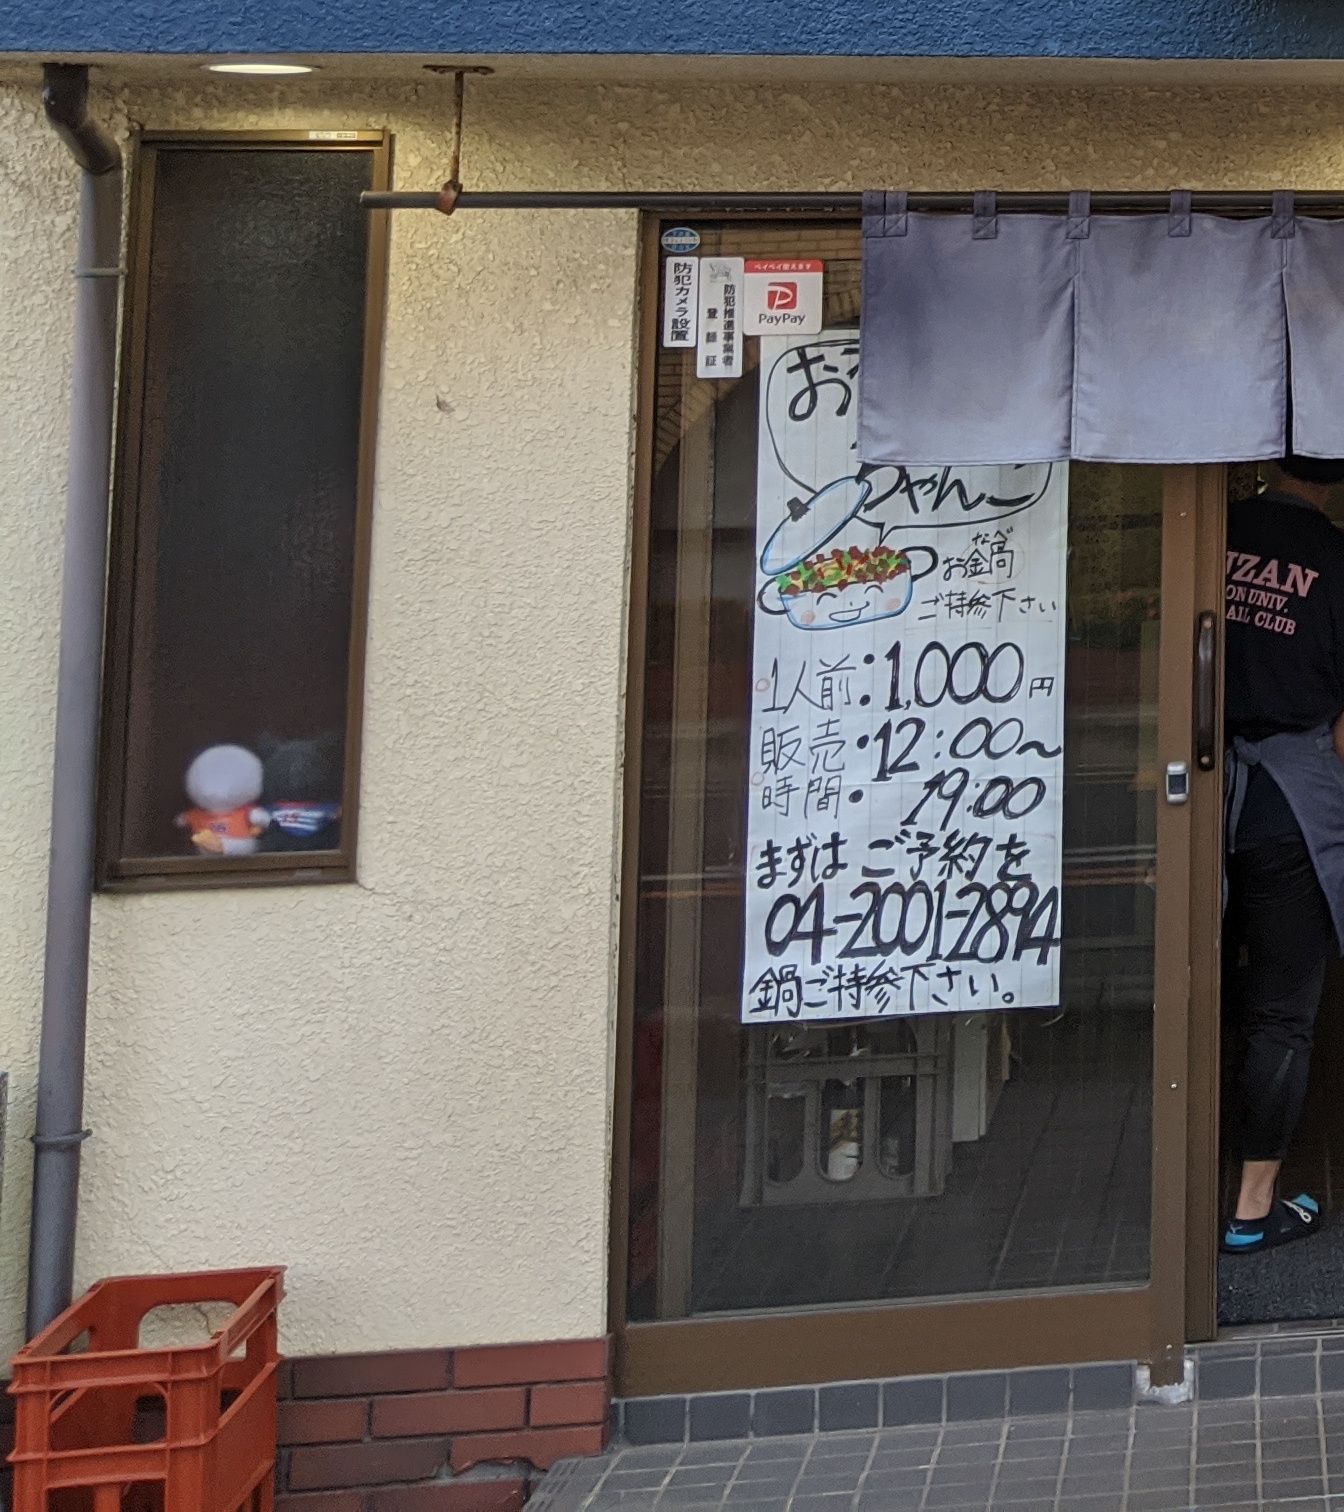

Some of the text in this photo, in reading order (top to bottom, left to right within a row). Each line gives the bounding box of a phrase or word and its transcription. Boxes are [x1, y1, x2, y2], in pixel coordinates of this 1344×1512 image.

[670, 262, 693, 342] 防犯カメラ設置
[758, 313, 806, 326] PayPay
[918, 588, 1057, 622] ご持参下さい
[1248, 589, 1289, 613] UNIV.
[1254, 611, 1297, 636] CLUB
[764, 880, 1061, 965] 04-2001-2894
